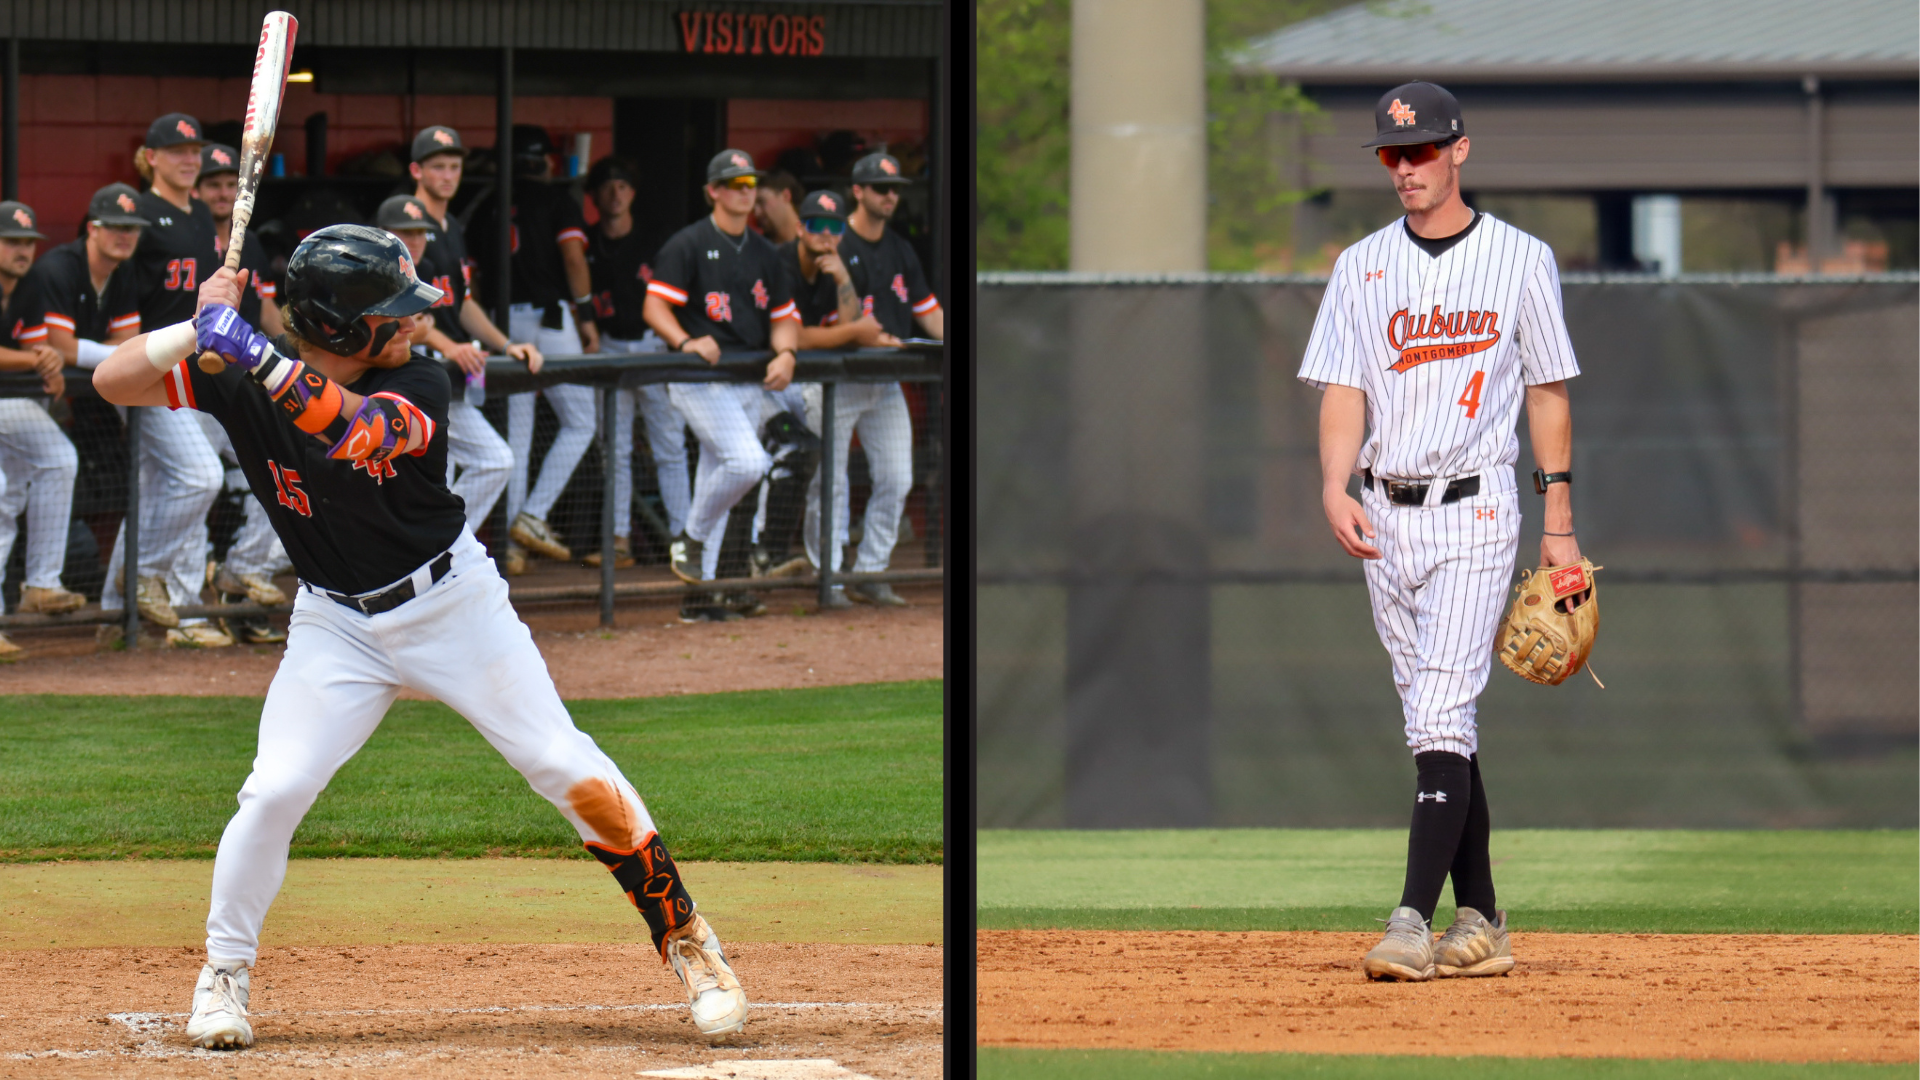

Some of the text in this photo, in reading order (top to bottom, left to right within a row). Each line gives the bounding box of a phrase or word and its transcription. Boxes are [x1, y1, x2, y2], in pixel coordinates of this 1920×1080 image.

[680, 11, 825, 56] VISITORS
[164, 258, 197, 291] 37
[1387, 304, 1500, 351] Auburn
[1398, 343, 1476, 367] MONTGOMERY
[1457, 370, 1486, 420] 4
[267, 459, 313, 518] 15
